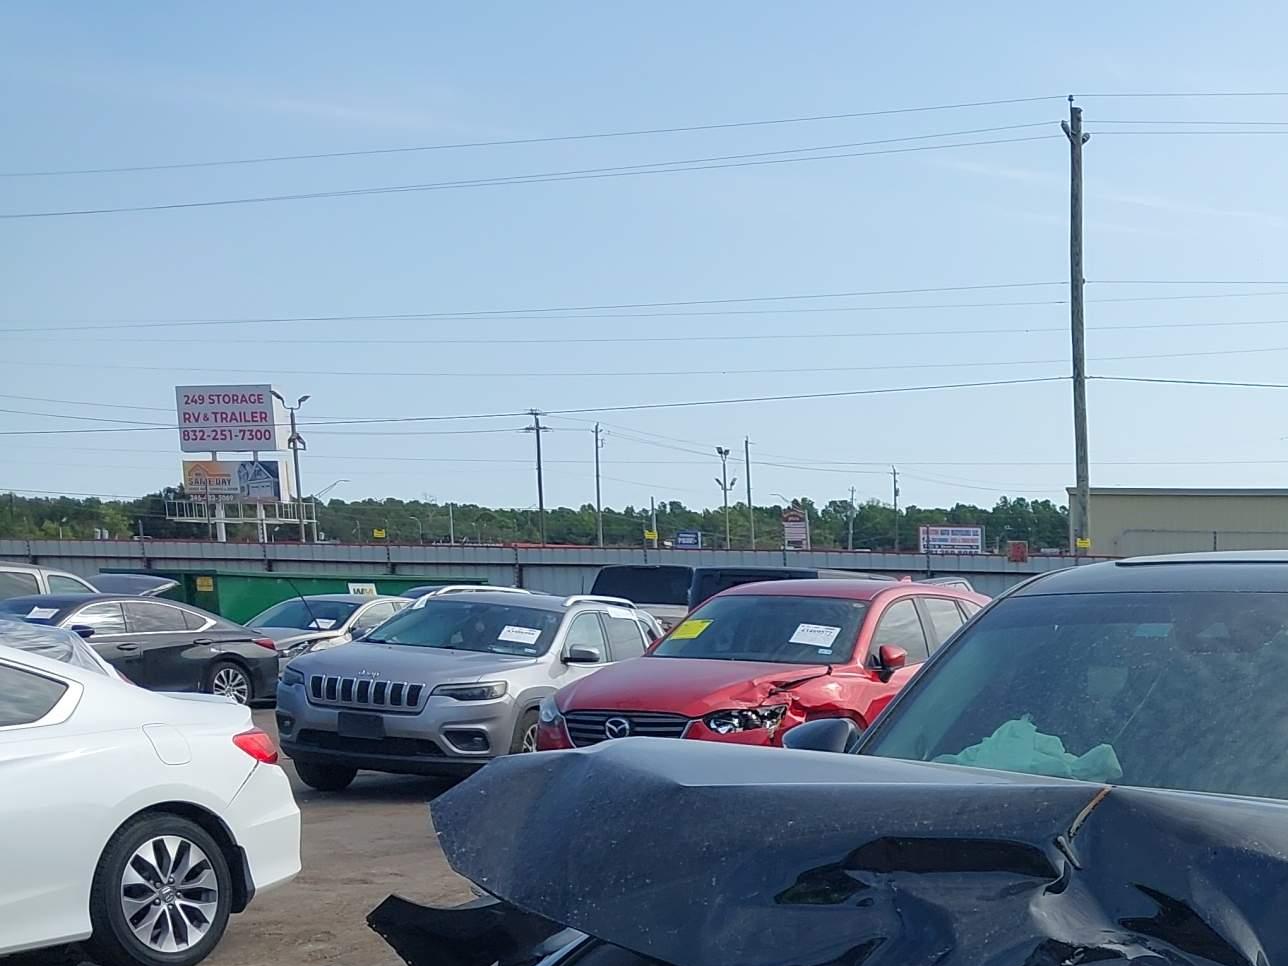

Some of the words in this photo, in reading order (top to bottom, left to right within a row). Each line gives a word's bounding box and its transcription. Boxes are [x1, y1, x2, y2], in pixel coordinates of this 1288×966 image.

[183, 394, 205, 405] 249
[208, 393, 264, 405] STORAGE
[183, 411, 201, 423] RV
[203, 414, 209, 422] &
[212, 411, 268, 423] TRAILER
[182, 429, 272, 441] 832-251-7300
